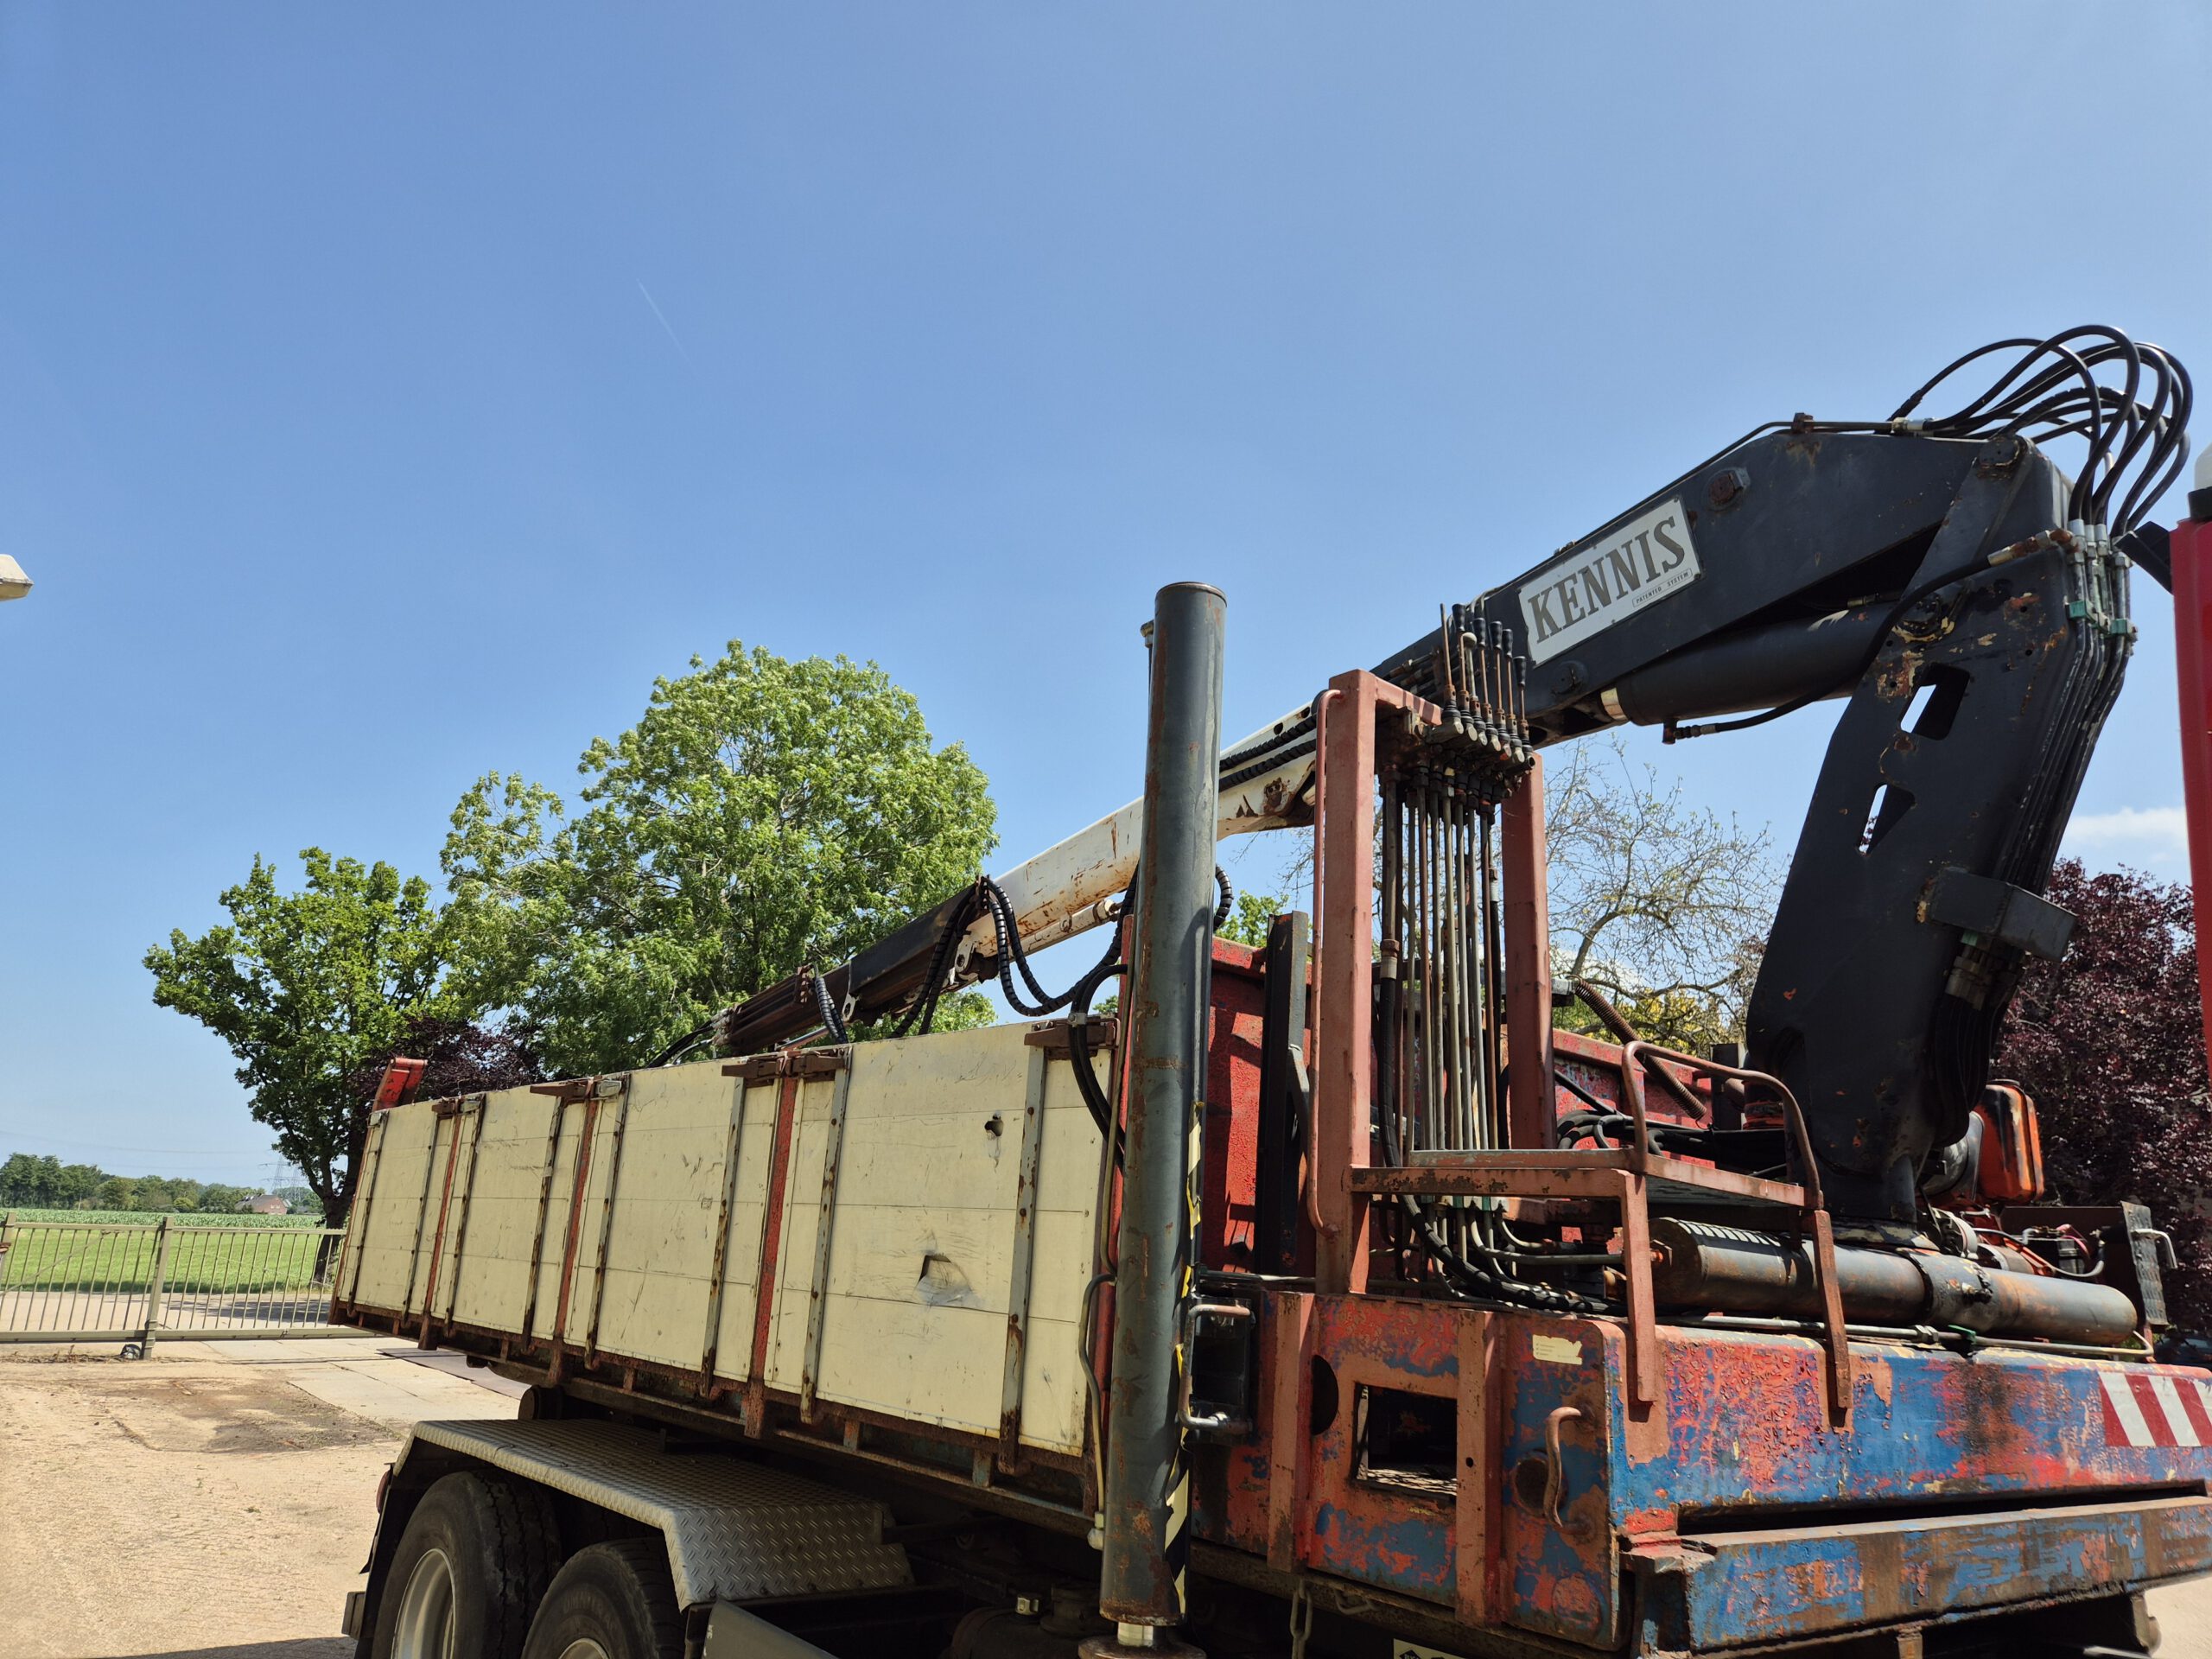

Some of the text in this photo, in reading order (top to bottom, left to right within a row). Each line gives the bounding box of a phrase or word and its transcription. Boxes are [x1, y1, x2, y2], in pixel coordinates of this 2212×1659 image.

[1528, 516, 1685, 644] KENNIS
[1636, 571, 1688, 604] PATENTED SYSTEM
